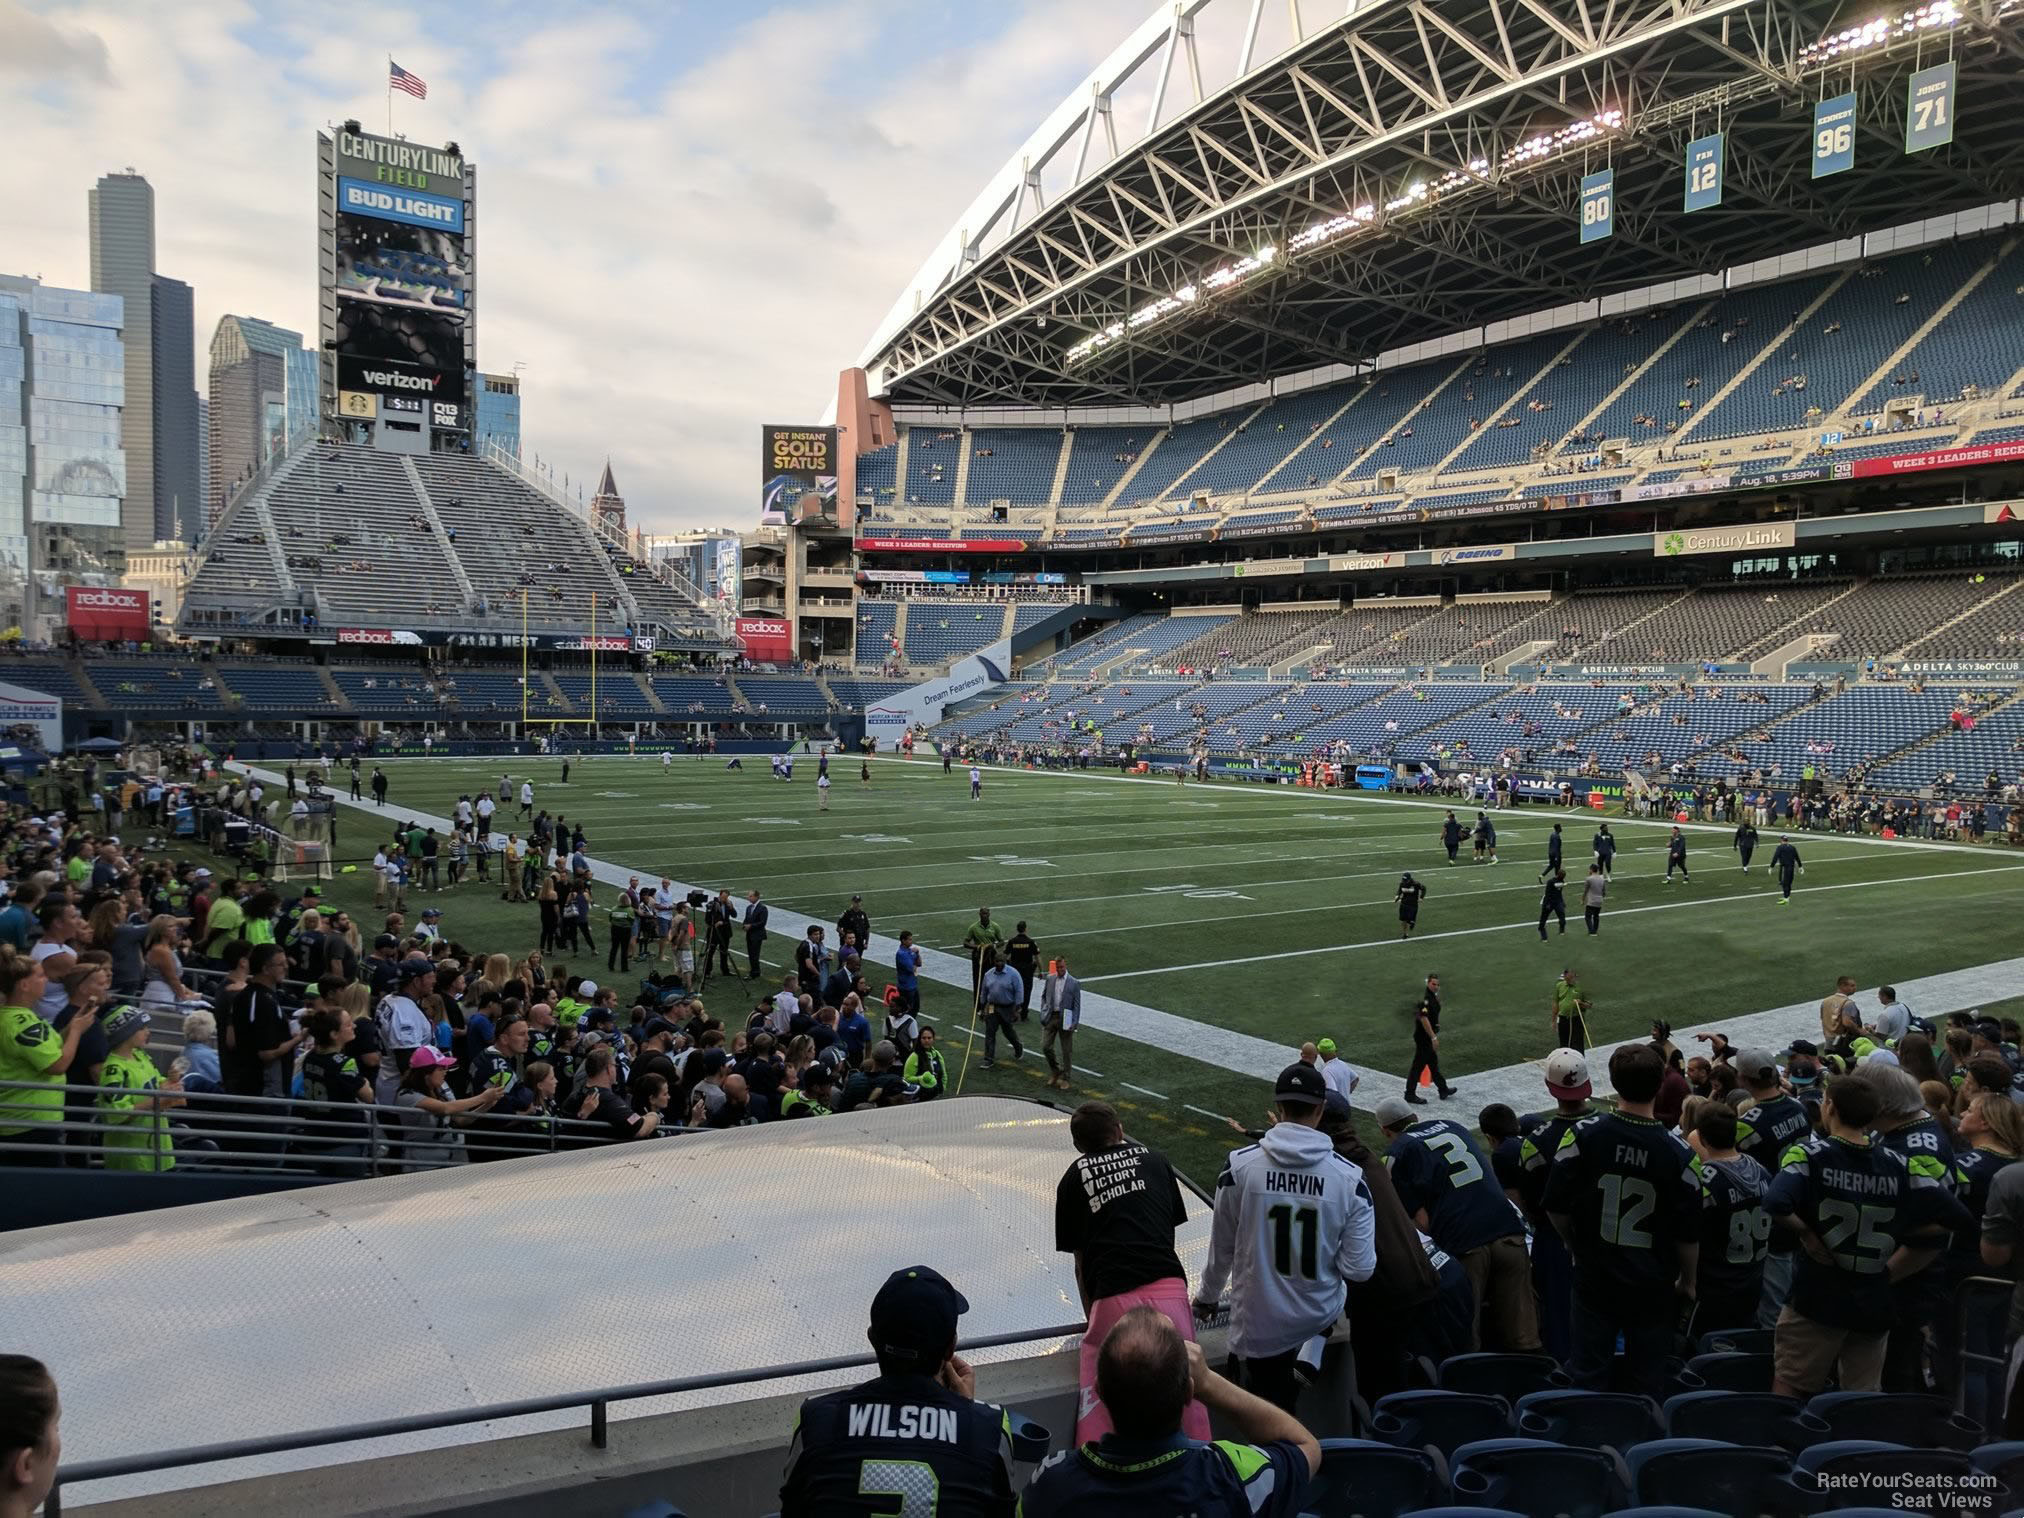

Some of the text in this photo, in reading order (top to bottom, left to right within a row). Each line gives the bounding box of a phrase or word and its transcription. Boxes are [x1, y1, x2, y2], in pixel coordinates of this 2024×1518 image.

[1916, 80, 1947, 97] JONES
[1817, 108, 1853, 127] KENNEDY
[1914, 95, 1947, 132] 71
[1816, 123, 1852, 158] 96
[340, 131, 462, 180] CENTURYLINK
[1695, 148, 1714, 161] FAN
[377, 165, 429, 189] FIELD
[1690, 162, 1716, 193] 12
[347, 187, 455, 223] BUD LIGHT
[1583, 195, 1610, 226] 80
[362, 370, 434, 392] verizon
[433, 402, 458, 416] Q13
[434, 414, 457, 426] FOX
[773, 432, 828, 441] GET INSTANT
[1825, 433, 1838, 444] 12
[773, 440, 827, 457] GOLD
[774, 456, 827, 470] STATUS
[1834, 464, 1852, 474] Q13
[1892, 457, 1926, 469] WEEK
[1927, 456, 1936, 465] 3
[1937, 450, 1992, 464] LEADERS:
[1739, 477, 1763, 487] Aug.
[1781, 470, 1820, 482] 5:39PM
[1834, 471, 1851, 479] NEWS
[1528, 501, 1538, 509] TD
[1408, 512, 1417, 520] TD
[1687, 528, 1782, 554] CenturyLink
[1342, 557, 1385, 571] verizon
[1455, 549, 1503, 560] BOEING
[502, 635, 539, 648] NEST
[637, 638, 653, 649] 40
[1589, 665, 1619, 674] DELTA
[1913, 662, 1953, 671] DELTA
[923, 674, 986, 706] Dream Fearlessly
[23, 704, 57, 713] FAMILY
[491, 1058, 508, 1071] 12
[1406, 1119, 1450, 1139] WILSON
[1770, 1112, 1808, 1141] BALDWIN
[1906, 1131, 1939, 1152] 88
[1077, 1146, 1150, 1170] CHARACTER
[1423, 1132, 1484, 1189] 3
[1615, 1143, 1649, 1169] FAN
[1080, 1156, 1142, 1184] ATTITUDE
[1083, 1167, 1137, 1198] VICTORY
[1266, 1170, 1326, 1197] HARVIN
[1822, 1167, 1899, 1197] SHERMAN
[1088, 1179, 1147, 1214] SCHOLAR
[1597, 1173, 1657, 1249] 12
[1267, 1203, 1319, 1281] 11
[1726, 1205, 1773, 1264] 89
[1818, 1197, 1897, 1274] 25
[848, 1403, 958, 1445] WILSON
